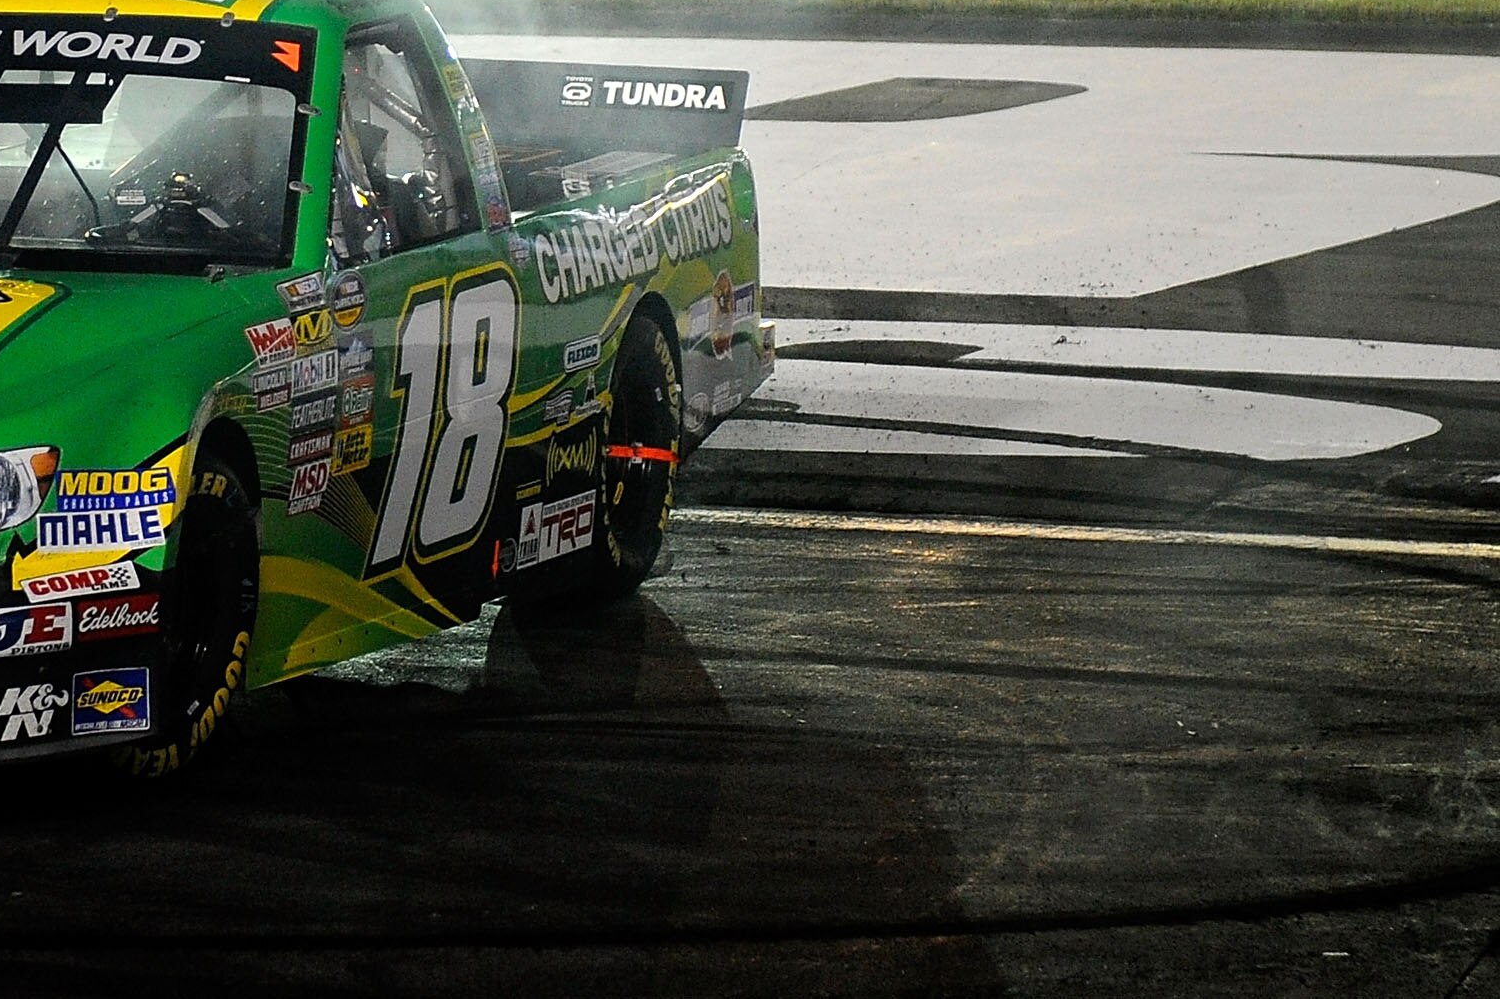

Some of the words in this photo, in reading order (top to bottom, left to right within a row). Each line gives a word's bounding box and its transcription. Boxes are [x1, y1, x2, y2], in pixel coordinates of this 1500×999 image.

[10, 29, 204, 66] WORLD
[602, 80, 727, 111] TUNDRA
[535, 208, 660, 303] CHARGED
[656, 182, 733, 264] CITRUS
[567, 343, 598, 366] FLEXCO
[293, 355, 324, 388] Mobil
[291, 396, 337, 429] FEATHERLITE
[370, 277, 519, 567] 18
[290, 433, 332, 460] CRAFTSMAN
[58, 468, 170, 497] MOOG
[293, 462, 328, 499] MSD
[63, 497, 116, 511] CHASSIS
[124, 491, 170, 507] PARTS
[39, 509, 163, 548] MAHLE
[27, 568, 111, 596] COMP
[91, 579, 129, 592] CAMS
[78, 602, 160, 633] Edelbrock
[10, 641, 71, 656] PISTONS
[78, 689, 142, 708] SUNOCO
